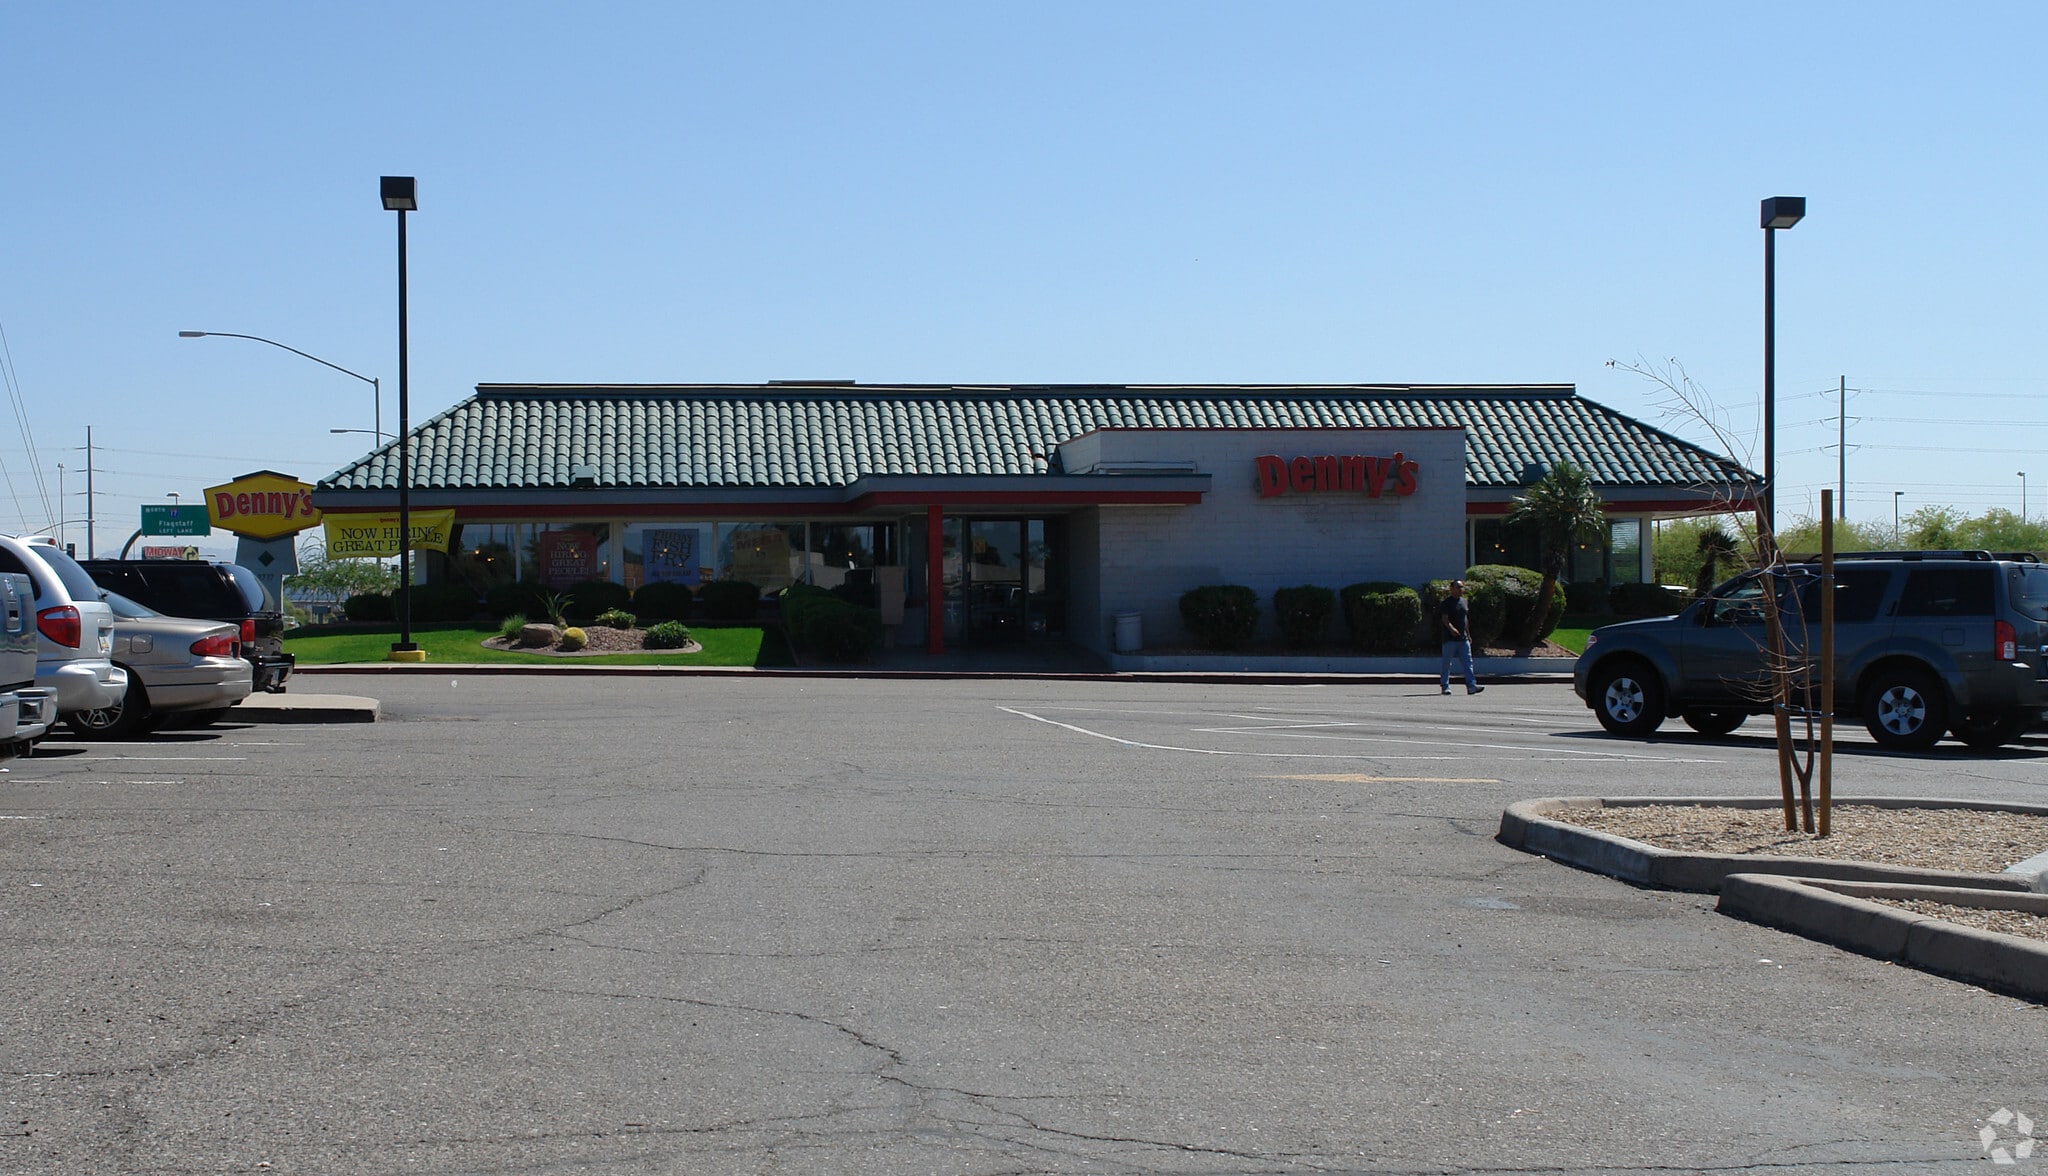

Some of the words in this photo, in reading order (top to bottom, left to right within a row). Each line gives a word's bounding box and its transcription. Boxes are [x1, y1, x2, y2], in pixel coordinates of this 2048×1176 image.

[1254, 451, 1419, 499] Denny's
[214, 488, 314, 519] Denny's
[158, 520, 194, 528] Flagstaff
[341, 527, 378, 540] NOW
[383, 526, 438, 539] HIIN
[144, 546, 184, 557] MIDWAY
[332, 540, 385, 553] GREAT
